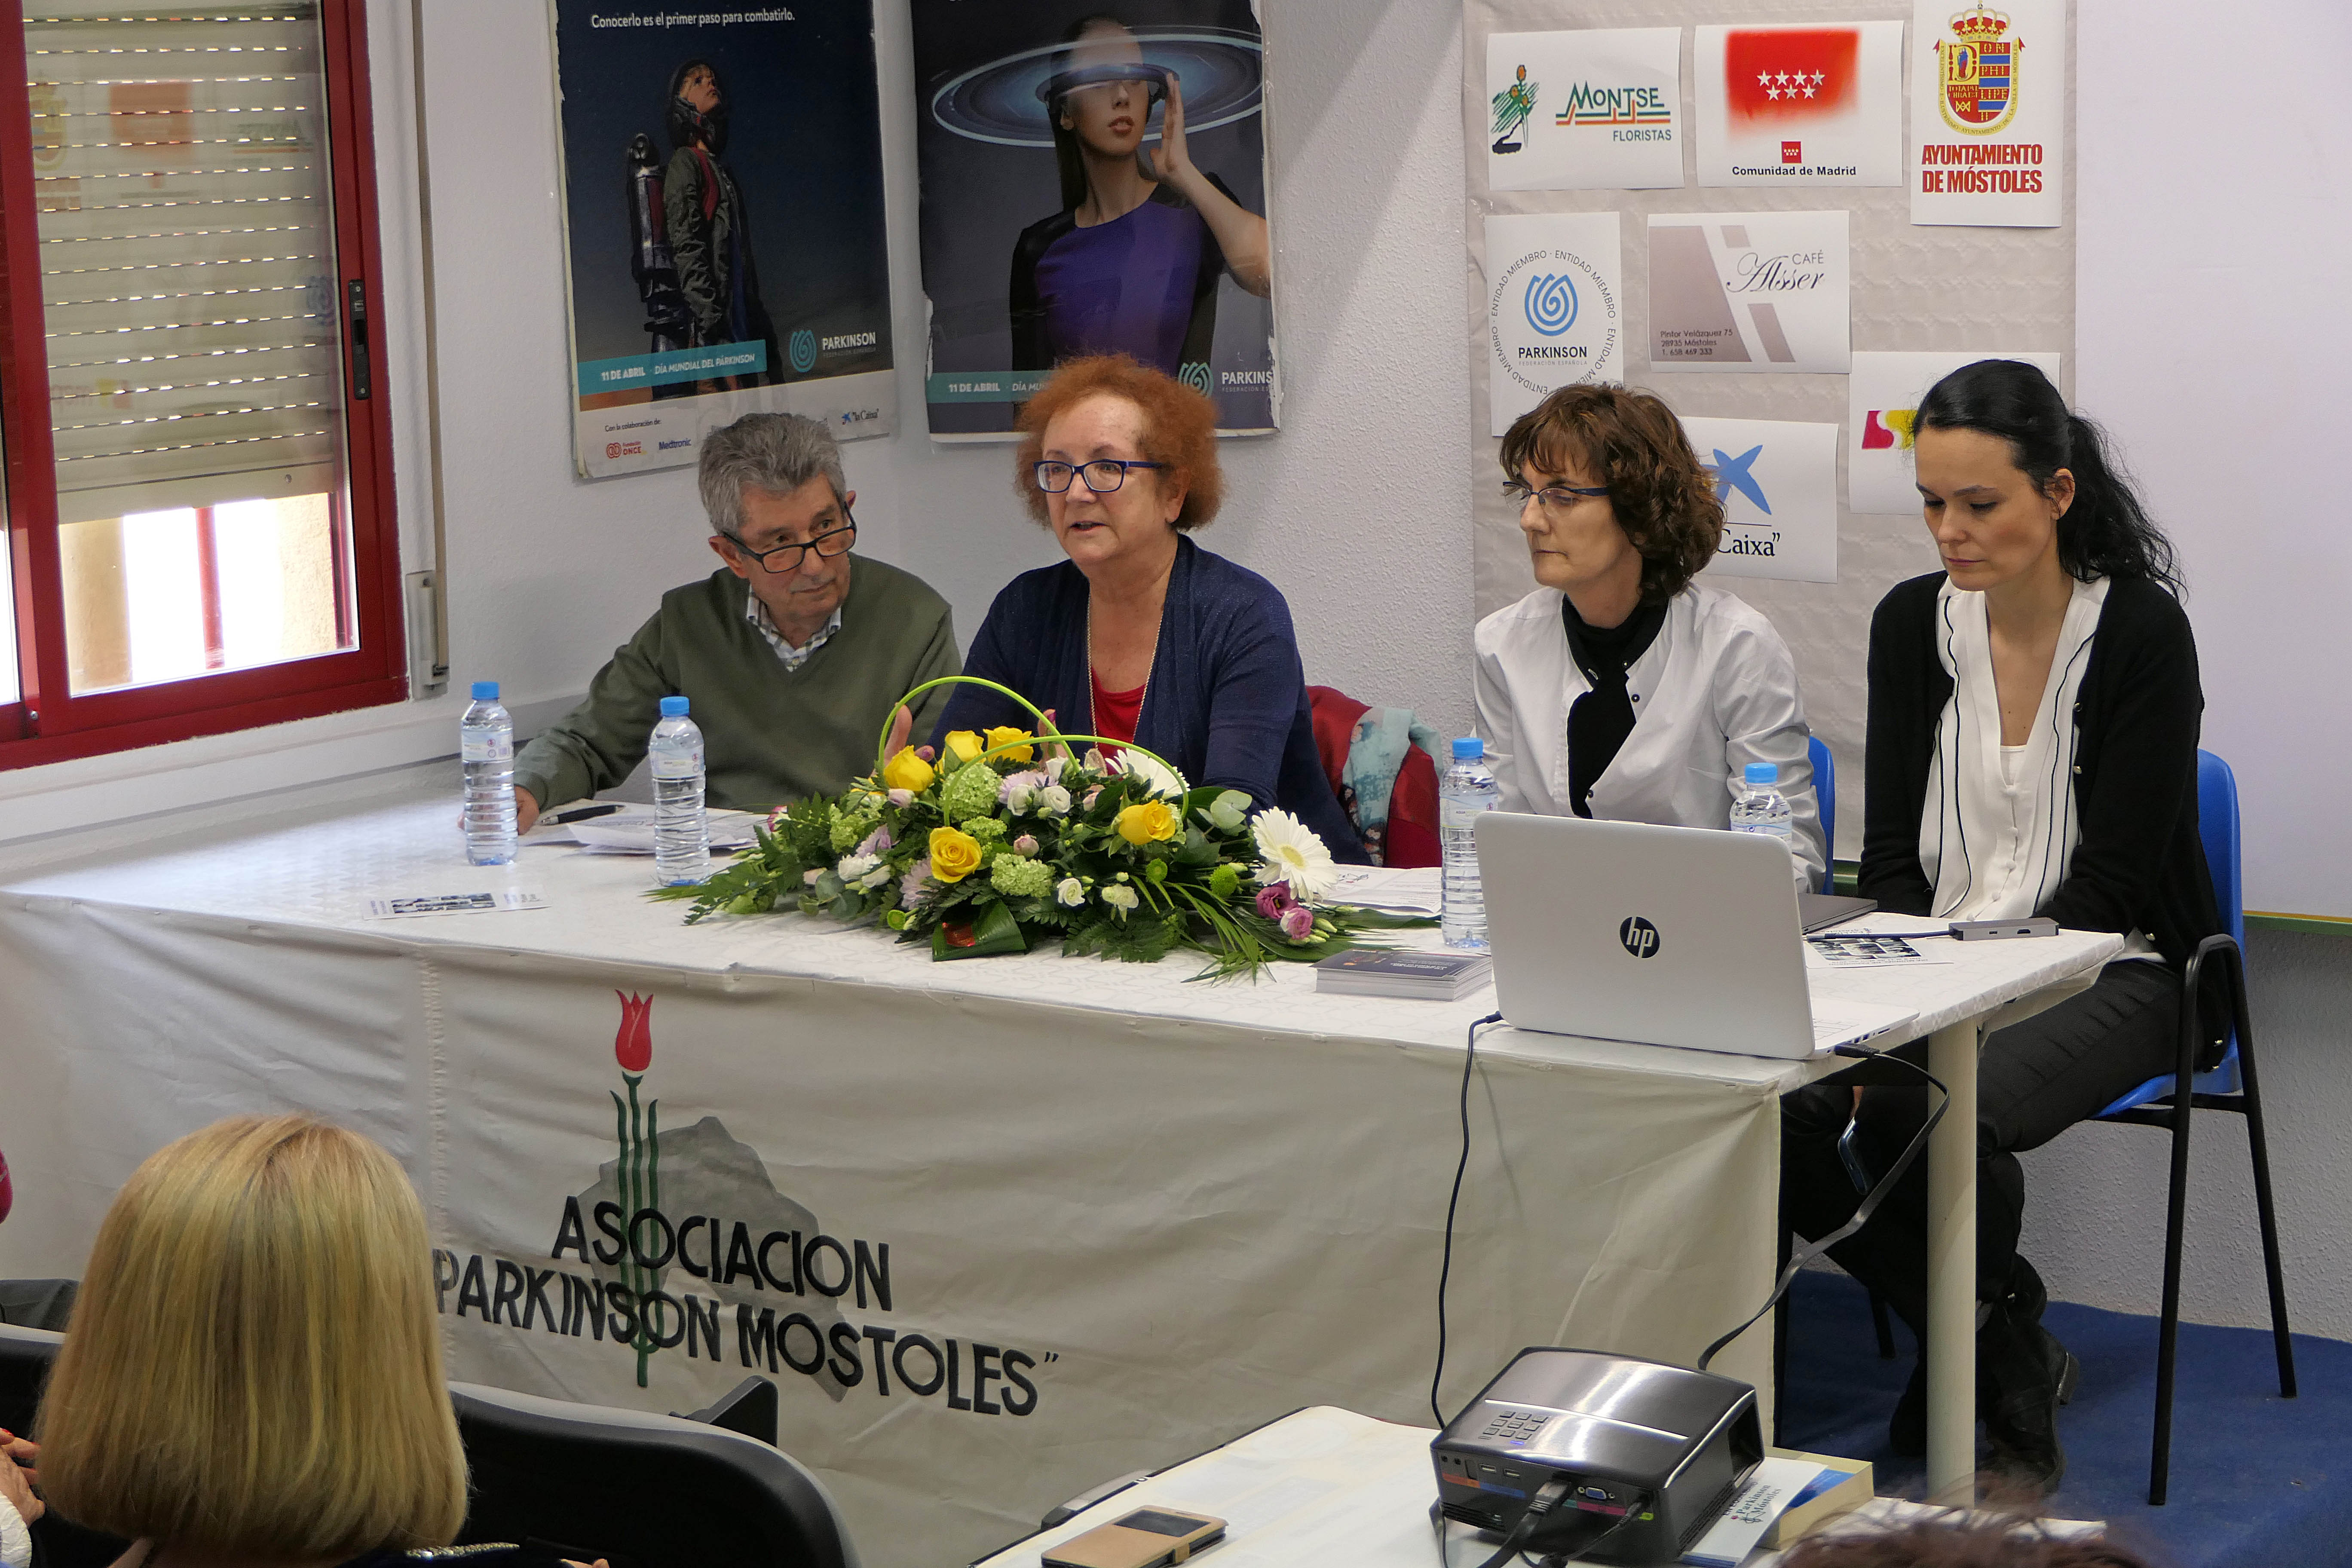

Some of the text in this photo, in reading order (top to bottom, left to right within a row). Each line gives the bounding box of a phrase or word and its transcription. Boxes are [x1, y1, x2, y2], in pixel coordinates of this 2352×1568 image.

[592, 7, 795, 29] Conocerlo es el primer paso para combatirlo.
[1565, 80, 1665, 115] MONTSE
[1613, 129, 1672, 141] FLORISTAS
[1921, 144, 2043, 165] AYUNTAMIENTO
[1732, 166, 1856, 175] Comunidad de Madrid
[1922, 165, 2043, 193] DE MÓSTOLES
[1792, 249, 1824, 265] CAFÉ
[1491, 250, 1547, 317] ENTIDAD MIEMBRO
[1555, 250, 1616, 318] ENTIDAD MIEMBRO
[823, 331, 876, 351] PARKINSON
[1518, 346, 1587, 358] PARKINSON
[1595, 328, 1616, 370] ENTIDAD
[601, 353, 755, 382] 11 DE ABRIL DÍA MUNDIAL DEL PÁRKINSON
[1491, 327, 1548, 395] ENTIDAD MIEMBRO
[949, 383, 958, 393] 11
[959, 383, 972, 392] DE
[973, 382, 1001, 392] ABRIL
[1012, 380, 1026, 392] DÍA
[622, 419, 653, 430] colaboración
[623, 446, 641, 455] ONCE
[658, 438, 692, 450] Medtronic
[1626, 916, 1655, 959] hp
[551, 1195, 892, 1312] ASOCIACION
[432, 1247, 722, 1363] PARKINSON
[1736, 1485, 1771, 1514] Parkinson
[1751, 1488, 1782, 1513] Móstoles
